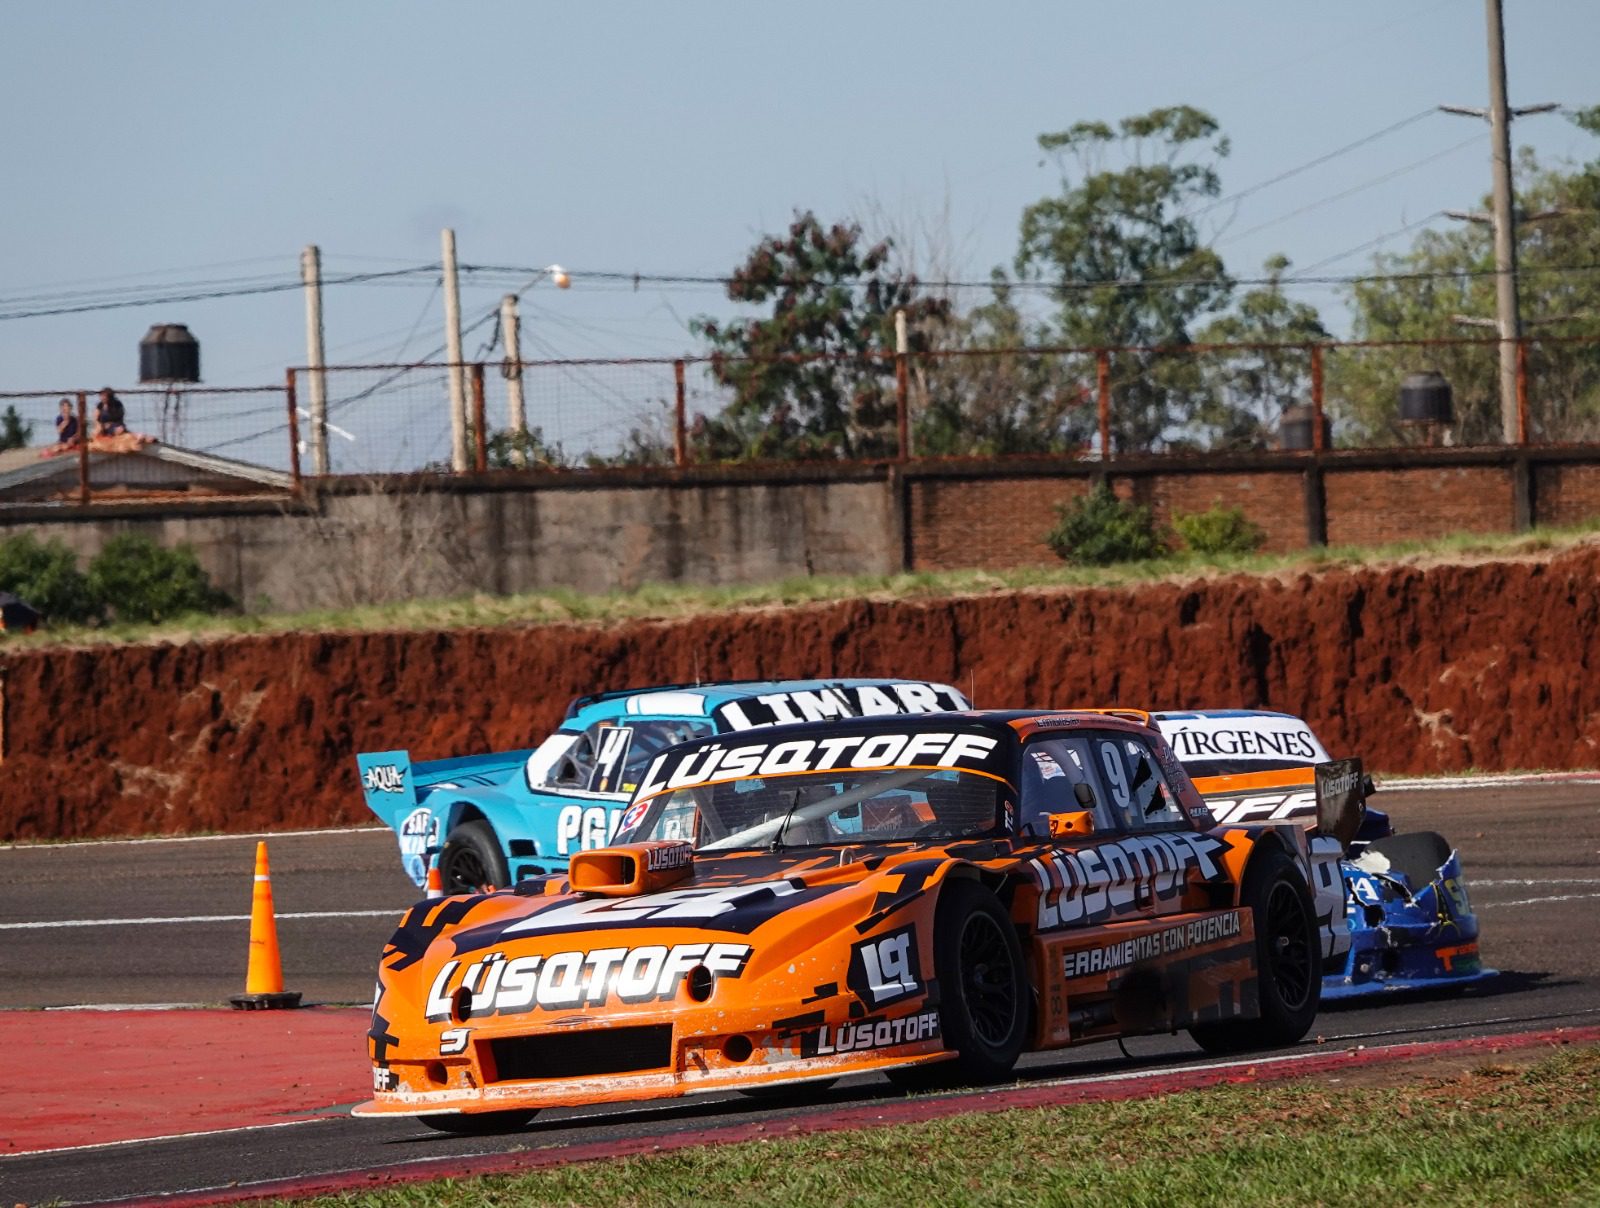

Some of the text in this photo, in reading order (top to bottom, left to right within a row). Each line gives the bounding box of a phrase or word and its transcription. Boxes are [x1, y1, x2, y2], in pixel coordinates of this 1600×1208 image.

[598, 729, 630, 777] 4
[631, 733, 999, 806] LÜSQTOFF
[1101, 741, 1130, 808] 9
[1163, 927, 1185, 953] CON
[1188, 911, 1240, 947] POTENCIA
[425, 943, 753, 1021] LÜSQTOFF
